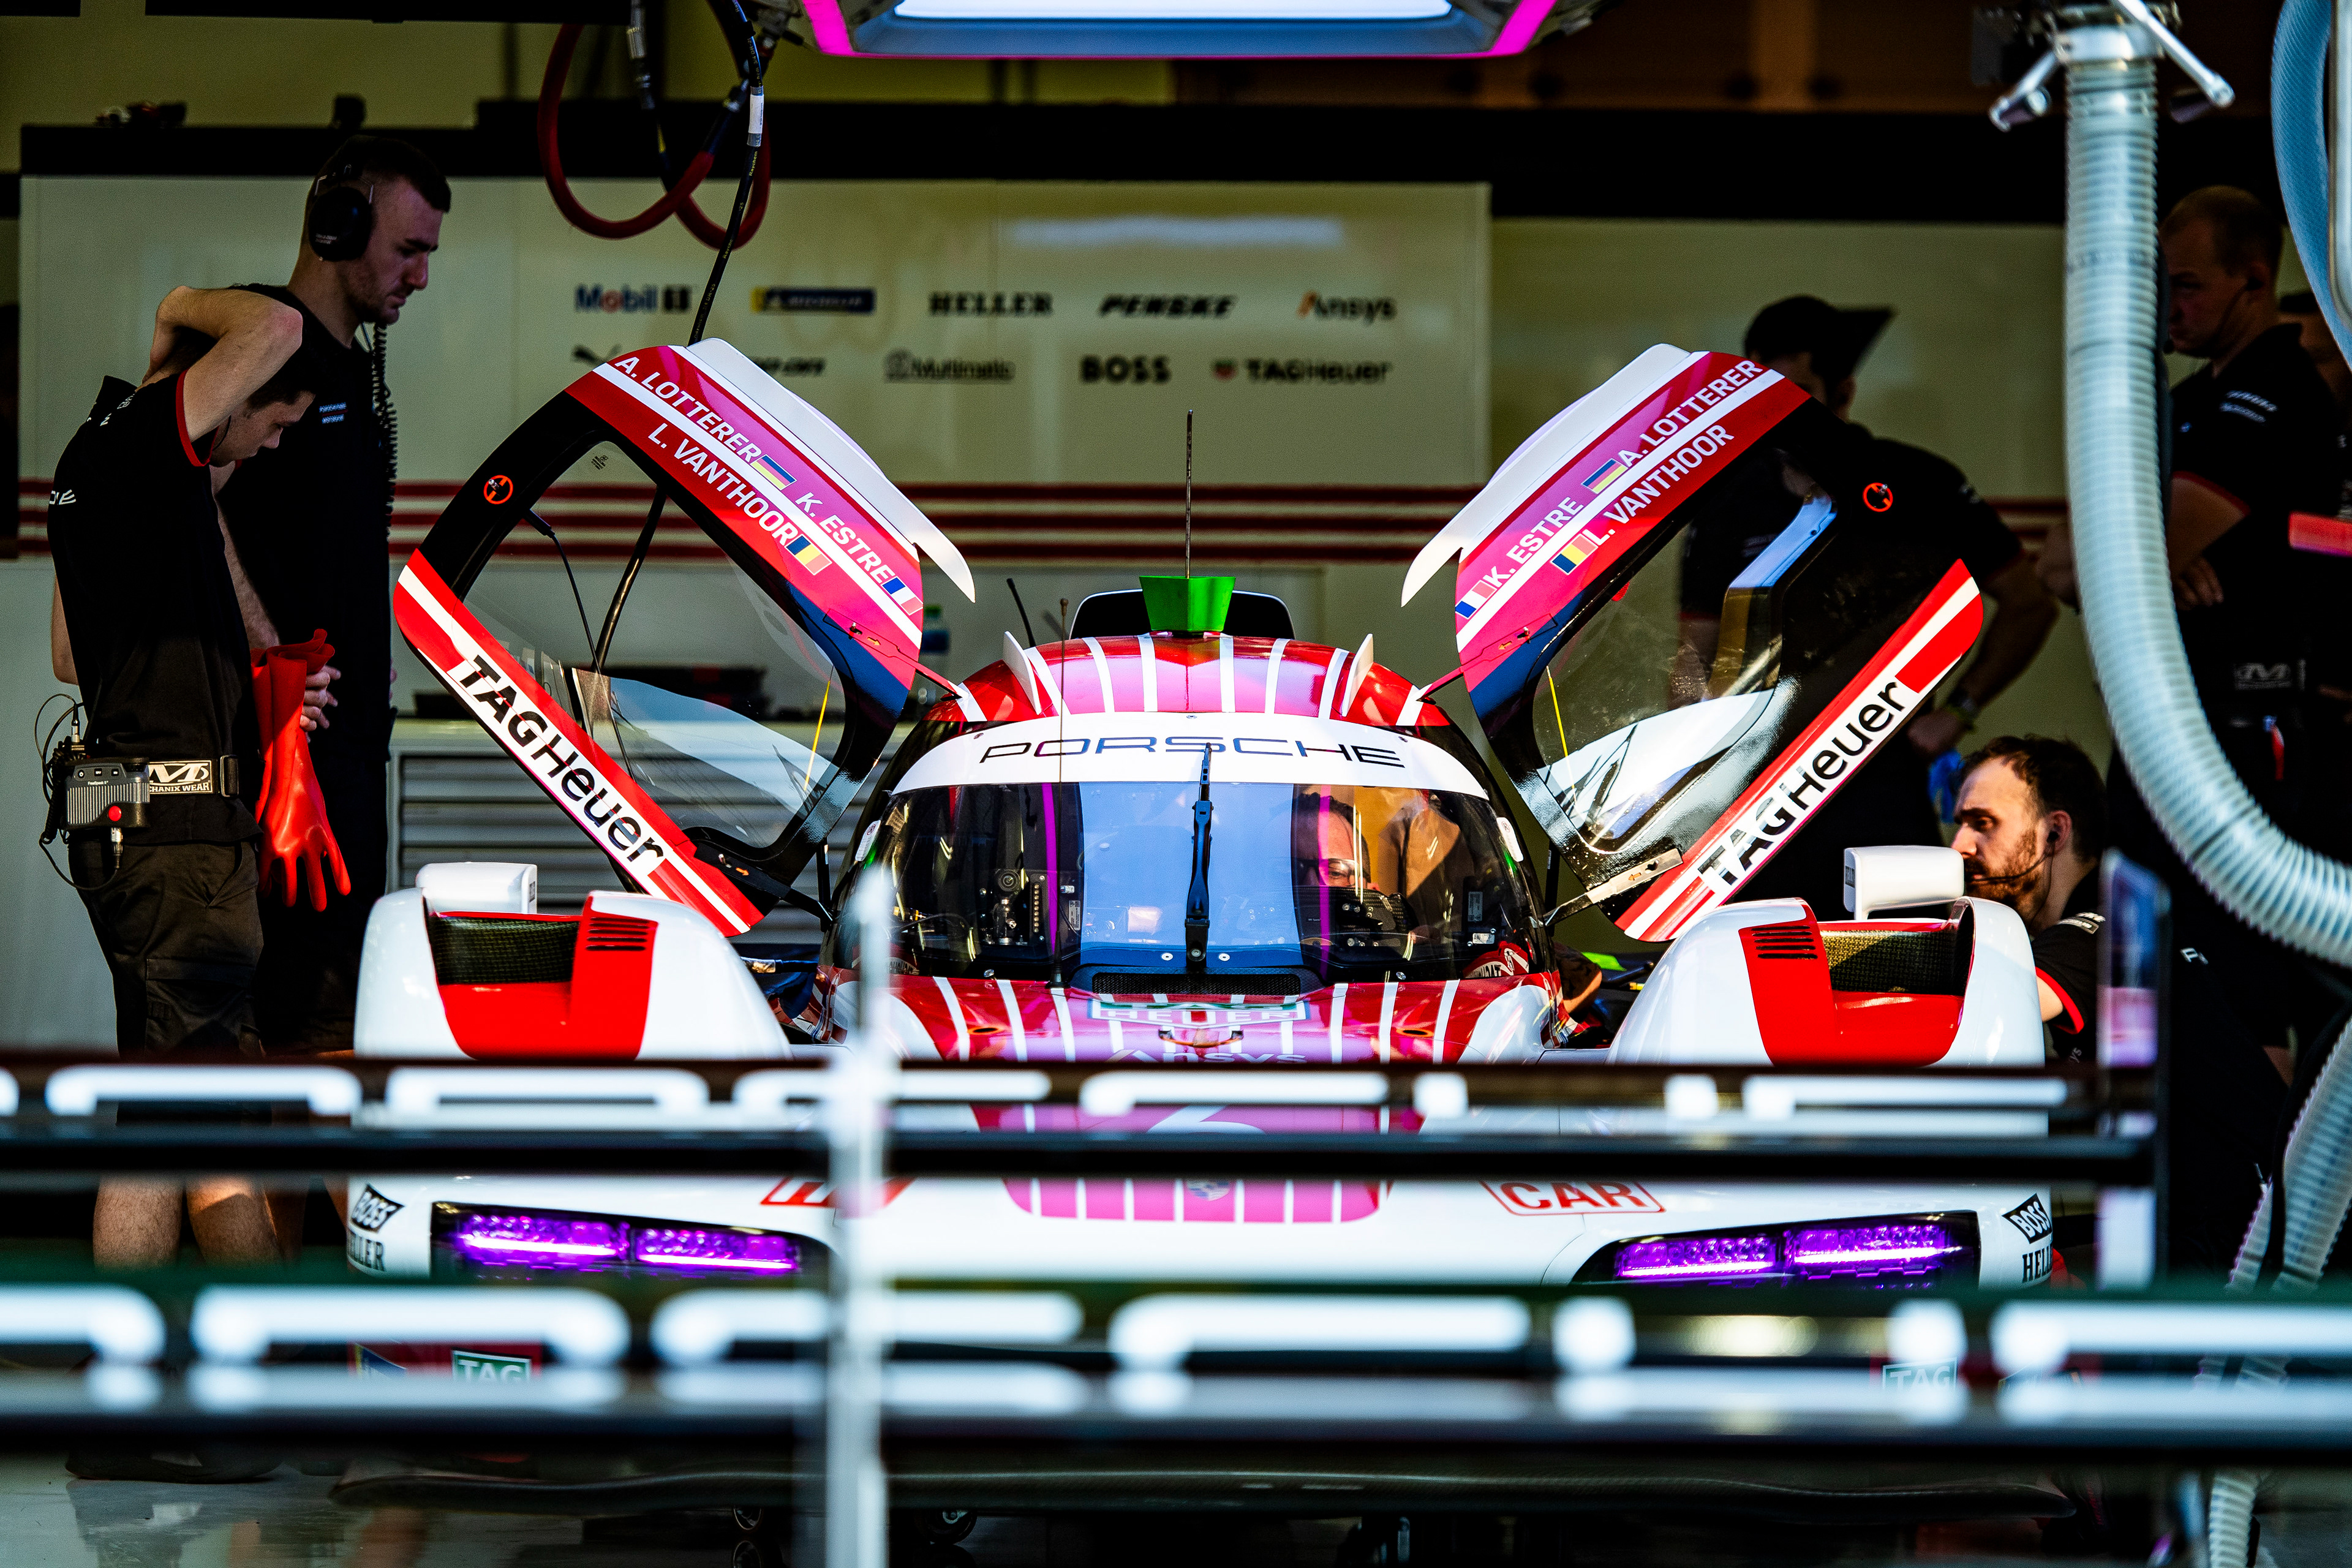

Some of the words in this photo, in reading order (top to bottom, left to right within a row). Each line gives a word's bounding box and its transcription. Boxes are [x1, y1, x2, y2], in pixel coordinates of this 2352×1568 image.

[930, 292, 1053, 316] HELLER
[1080, 355, 1169, 383] BOSS
[614, 357, 637, 378] A.
[641, 371, 762, 463] LOTTERER
[1619, 447, 1648, 468] A.
[1640, 359, 1763, 445] LOTTERER
[648, 423, 668, 448] L.
[674, 439, 792, 547] VANTHOOR
[1588, 528, 1615, 548] L.
[1603, 424, 1734, 524] VANTHOOR
[795, 492, 823, 518] K.
[819, 515, 895, 584] ESTRE
[1483, 562, 1516, 589] K.
[1506, 497, 1584, 566] ESTRE
[459, 655, 663, 862] TAGHeuer
[979, 736, 1406, 768] PORSCHE
[1697, 681, 1906, 886] TAGHeuer
[182, 783, 209, 791] WEAR
[1108, 1011, 1292, 1025] HEUER
[351, 1191, 398, 1229] BOSS
[1501, 1181, 1651, 1210] CAR
[2009, 1200, 2051, 1238] BOSS
